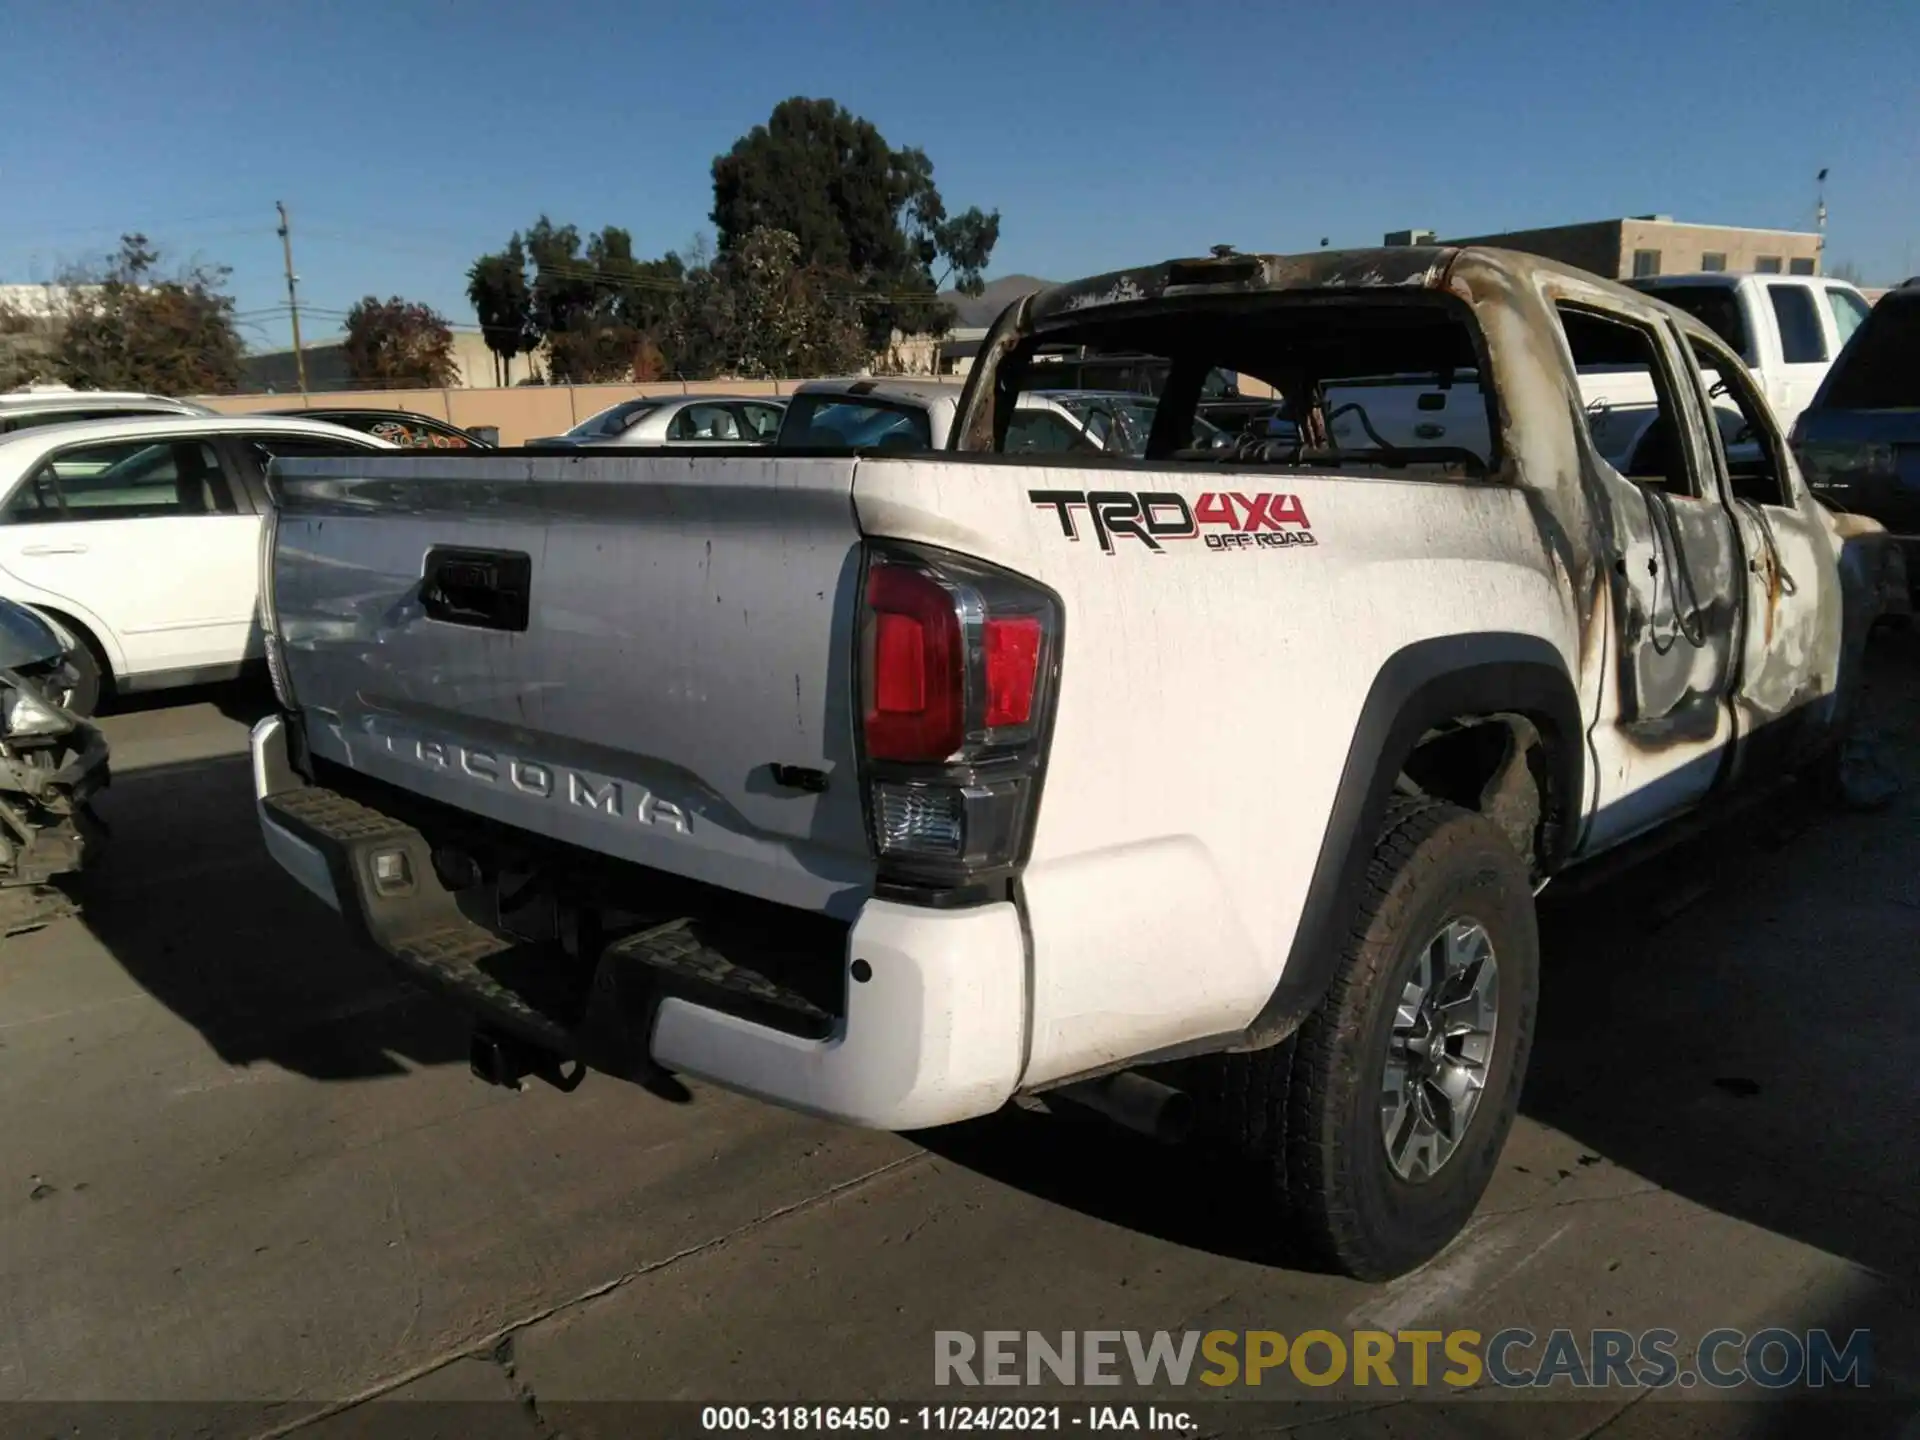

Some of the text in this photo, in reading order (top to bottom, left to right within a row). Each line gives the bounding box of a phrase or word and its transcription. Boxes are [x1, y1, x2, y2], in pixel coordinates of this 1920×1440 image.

[1028, 489, 1199, 556] TRD
[1204, 532, 1318, 551] OFF ROAD
